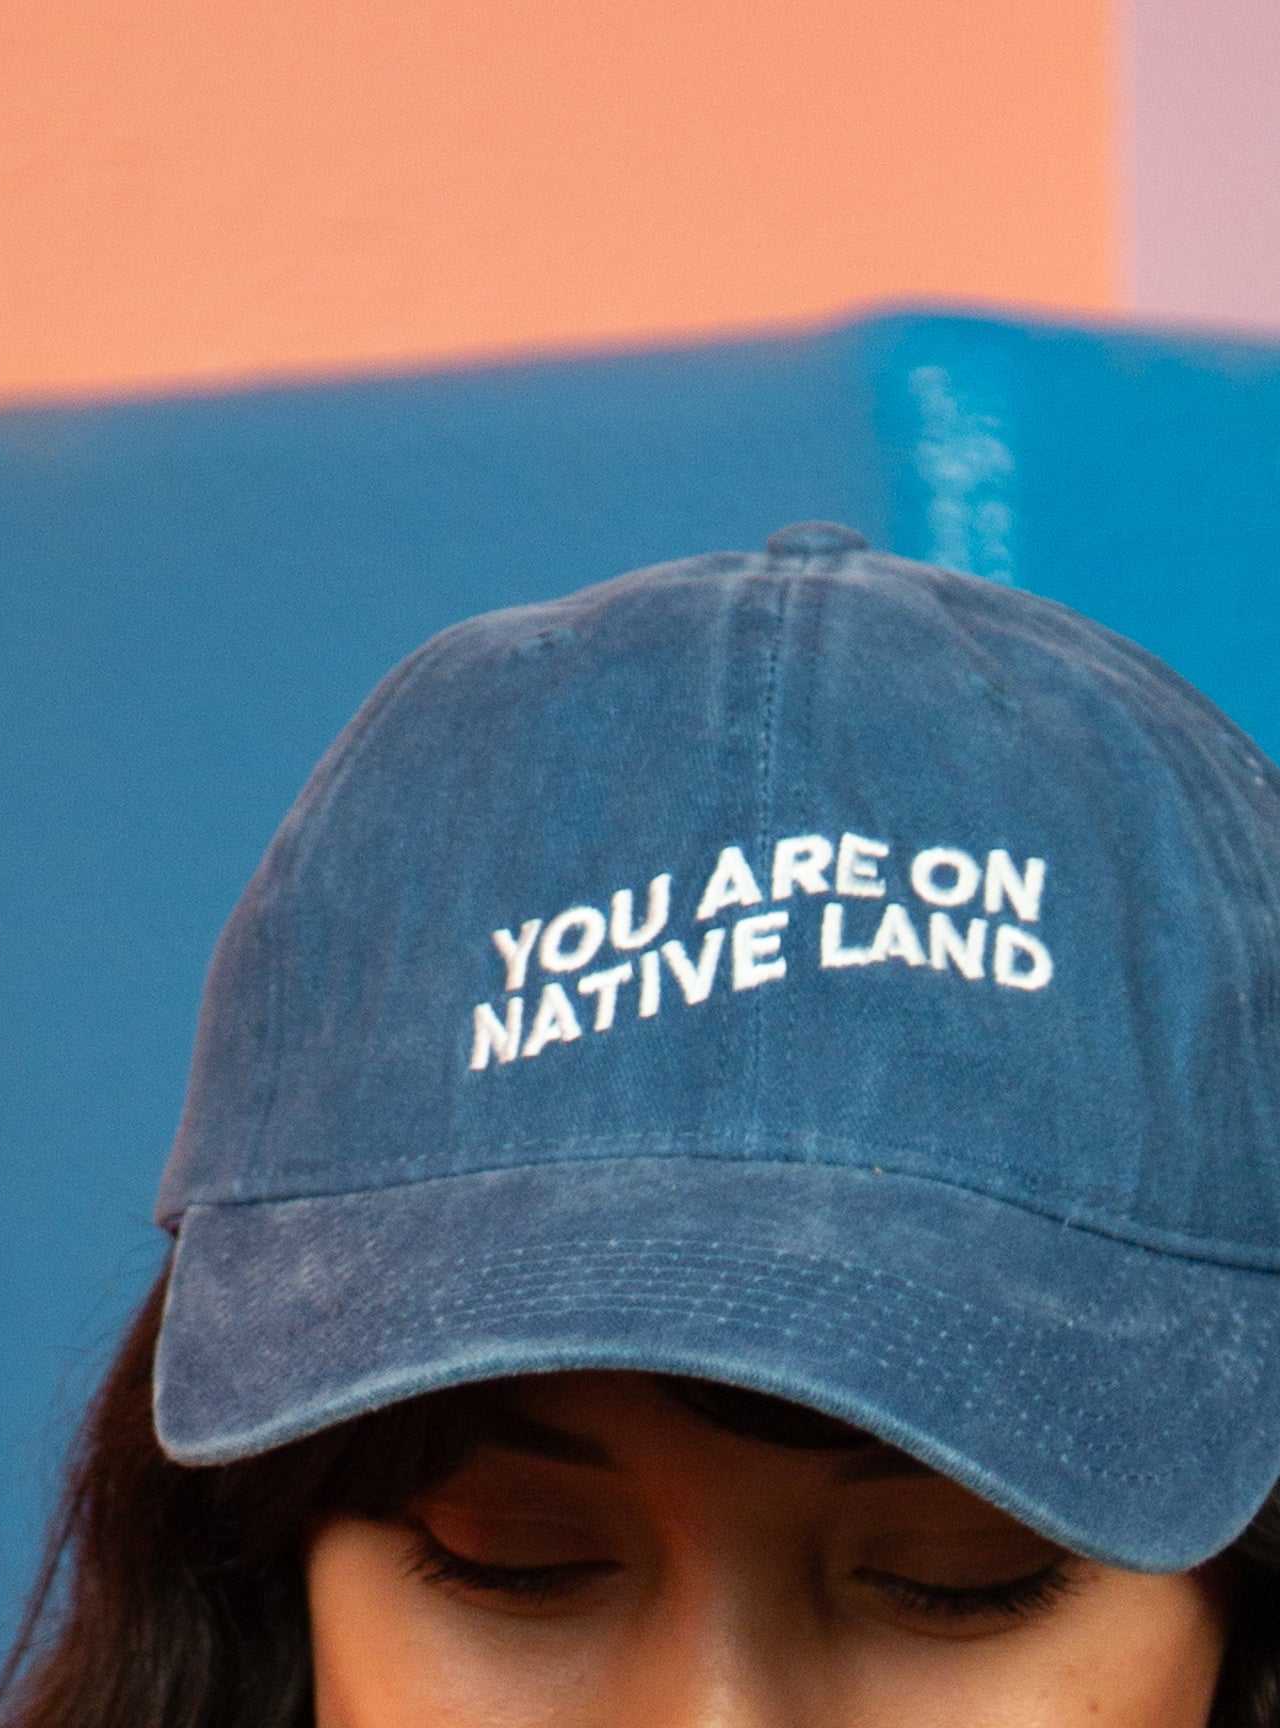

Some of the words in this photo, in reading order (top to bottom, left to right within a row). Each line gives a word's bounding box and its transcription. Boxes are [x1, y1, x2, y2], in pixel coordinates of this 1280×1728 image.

[469, 911, 790, 1071] NATIVE
[820, 902, 1053, 992] LAND
[492, 873, 672, 991] YOU
[696, 832, 889, 921] ARE
[910, 847, 1046, 922] ON
